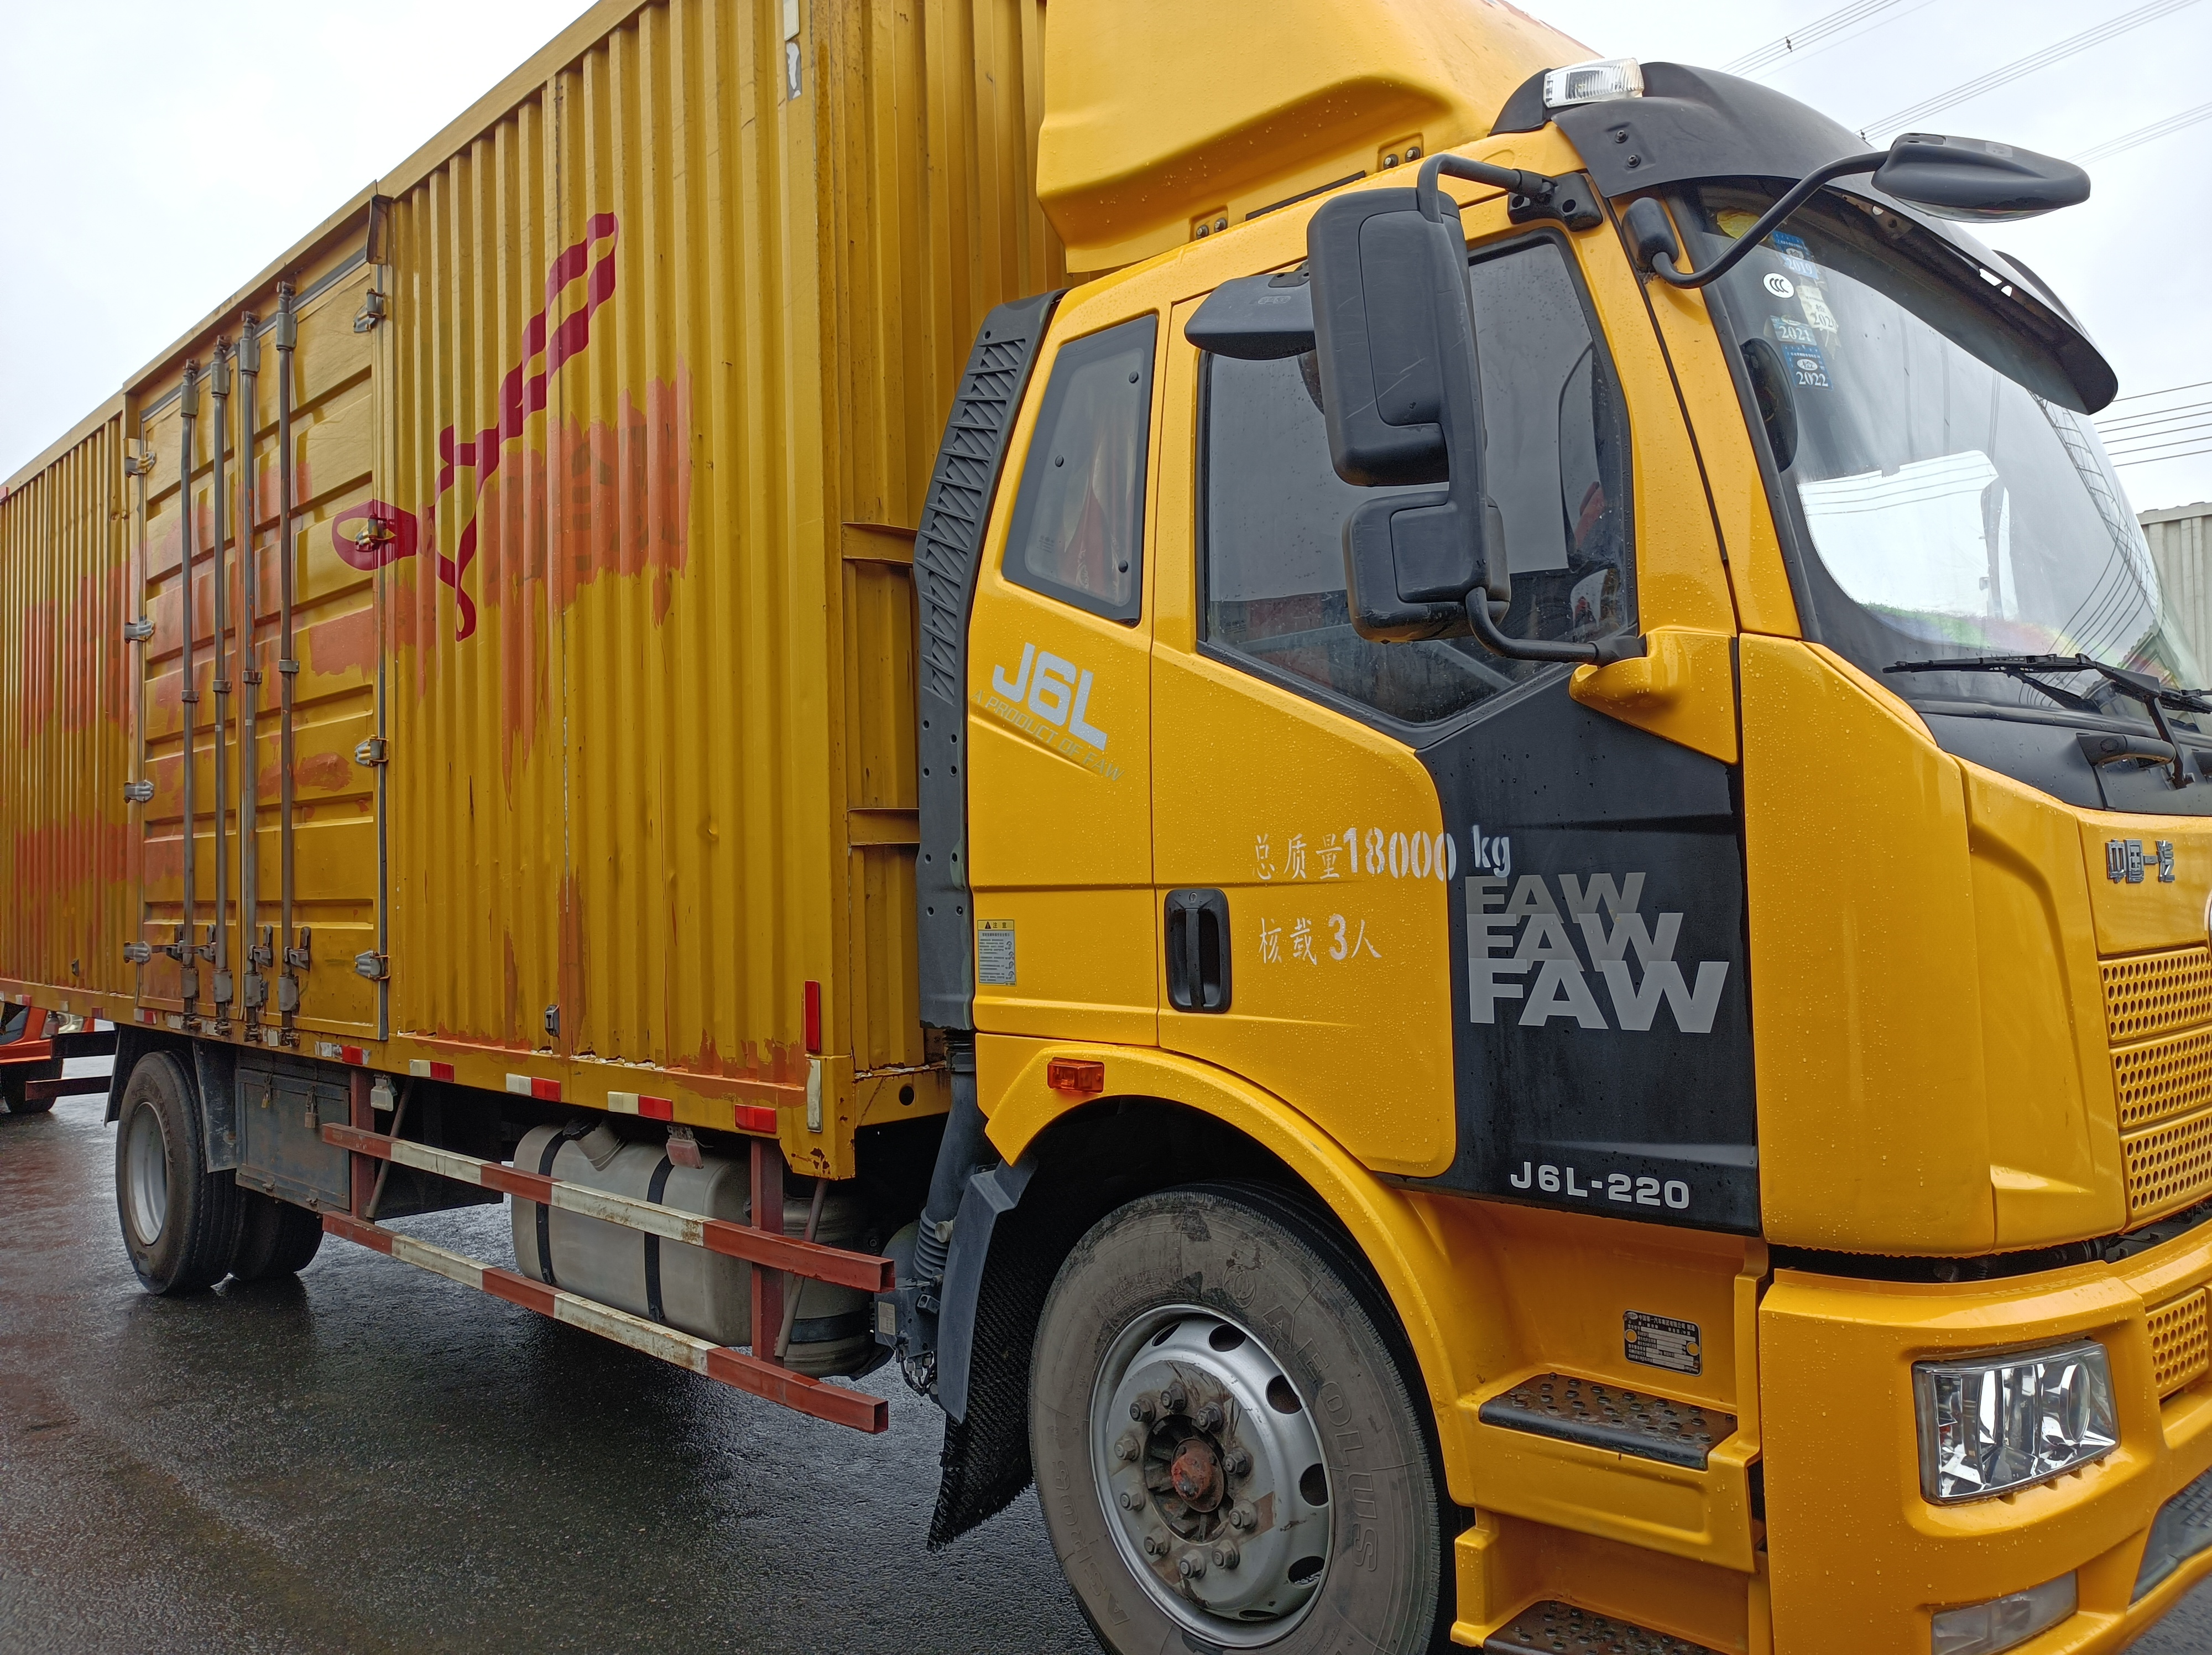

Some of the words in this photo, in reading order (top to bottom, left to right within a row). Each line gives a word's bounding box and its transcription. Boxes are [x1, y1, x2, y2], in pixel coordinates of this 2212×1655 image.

[1785, 257, 1813, 275] 2019
[1779, 325, 1812, 342] 2021
[1796, 371, 1828, 387] 2022
[992, 642, 1108, 751] J6L
[971, 690, 984, 704] A
[985, 696, 1058, 743] PRODUCT
[1057, 737, 1083, 757] OF
[1082, 752, 1125, 782] FAW
[1472, 825, 1511, 878] kg
[2105, 839, 2176, 884] 中国一汽
[1465, 872, 1646, 924] FAW
[1467, 913, 1683, 972] FAW
[1469, 958, 1730, 1033] FAW
[1510, 1162, 1689, 1209] J6L-220
[1262, 1304, 1379, 1572] AEOLUS
